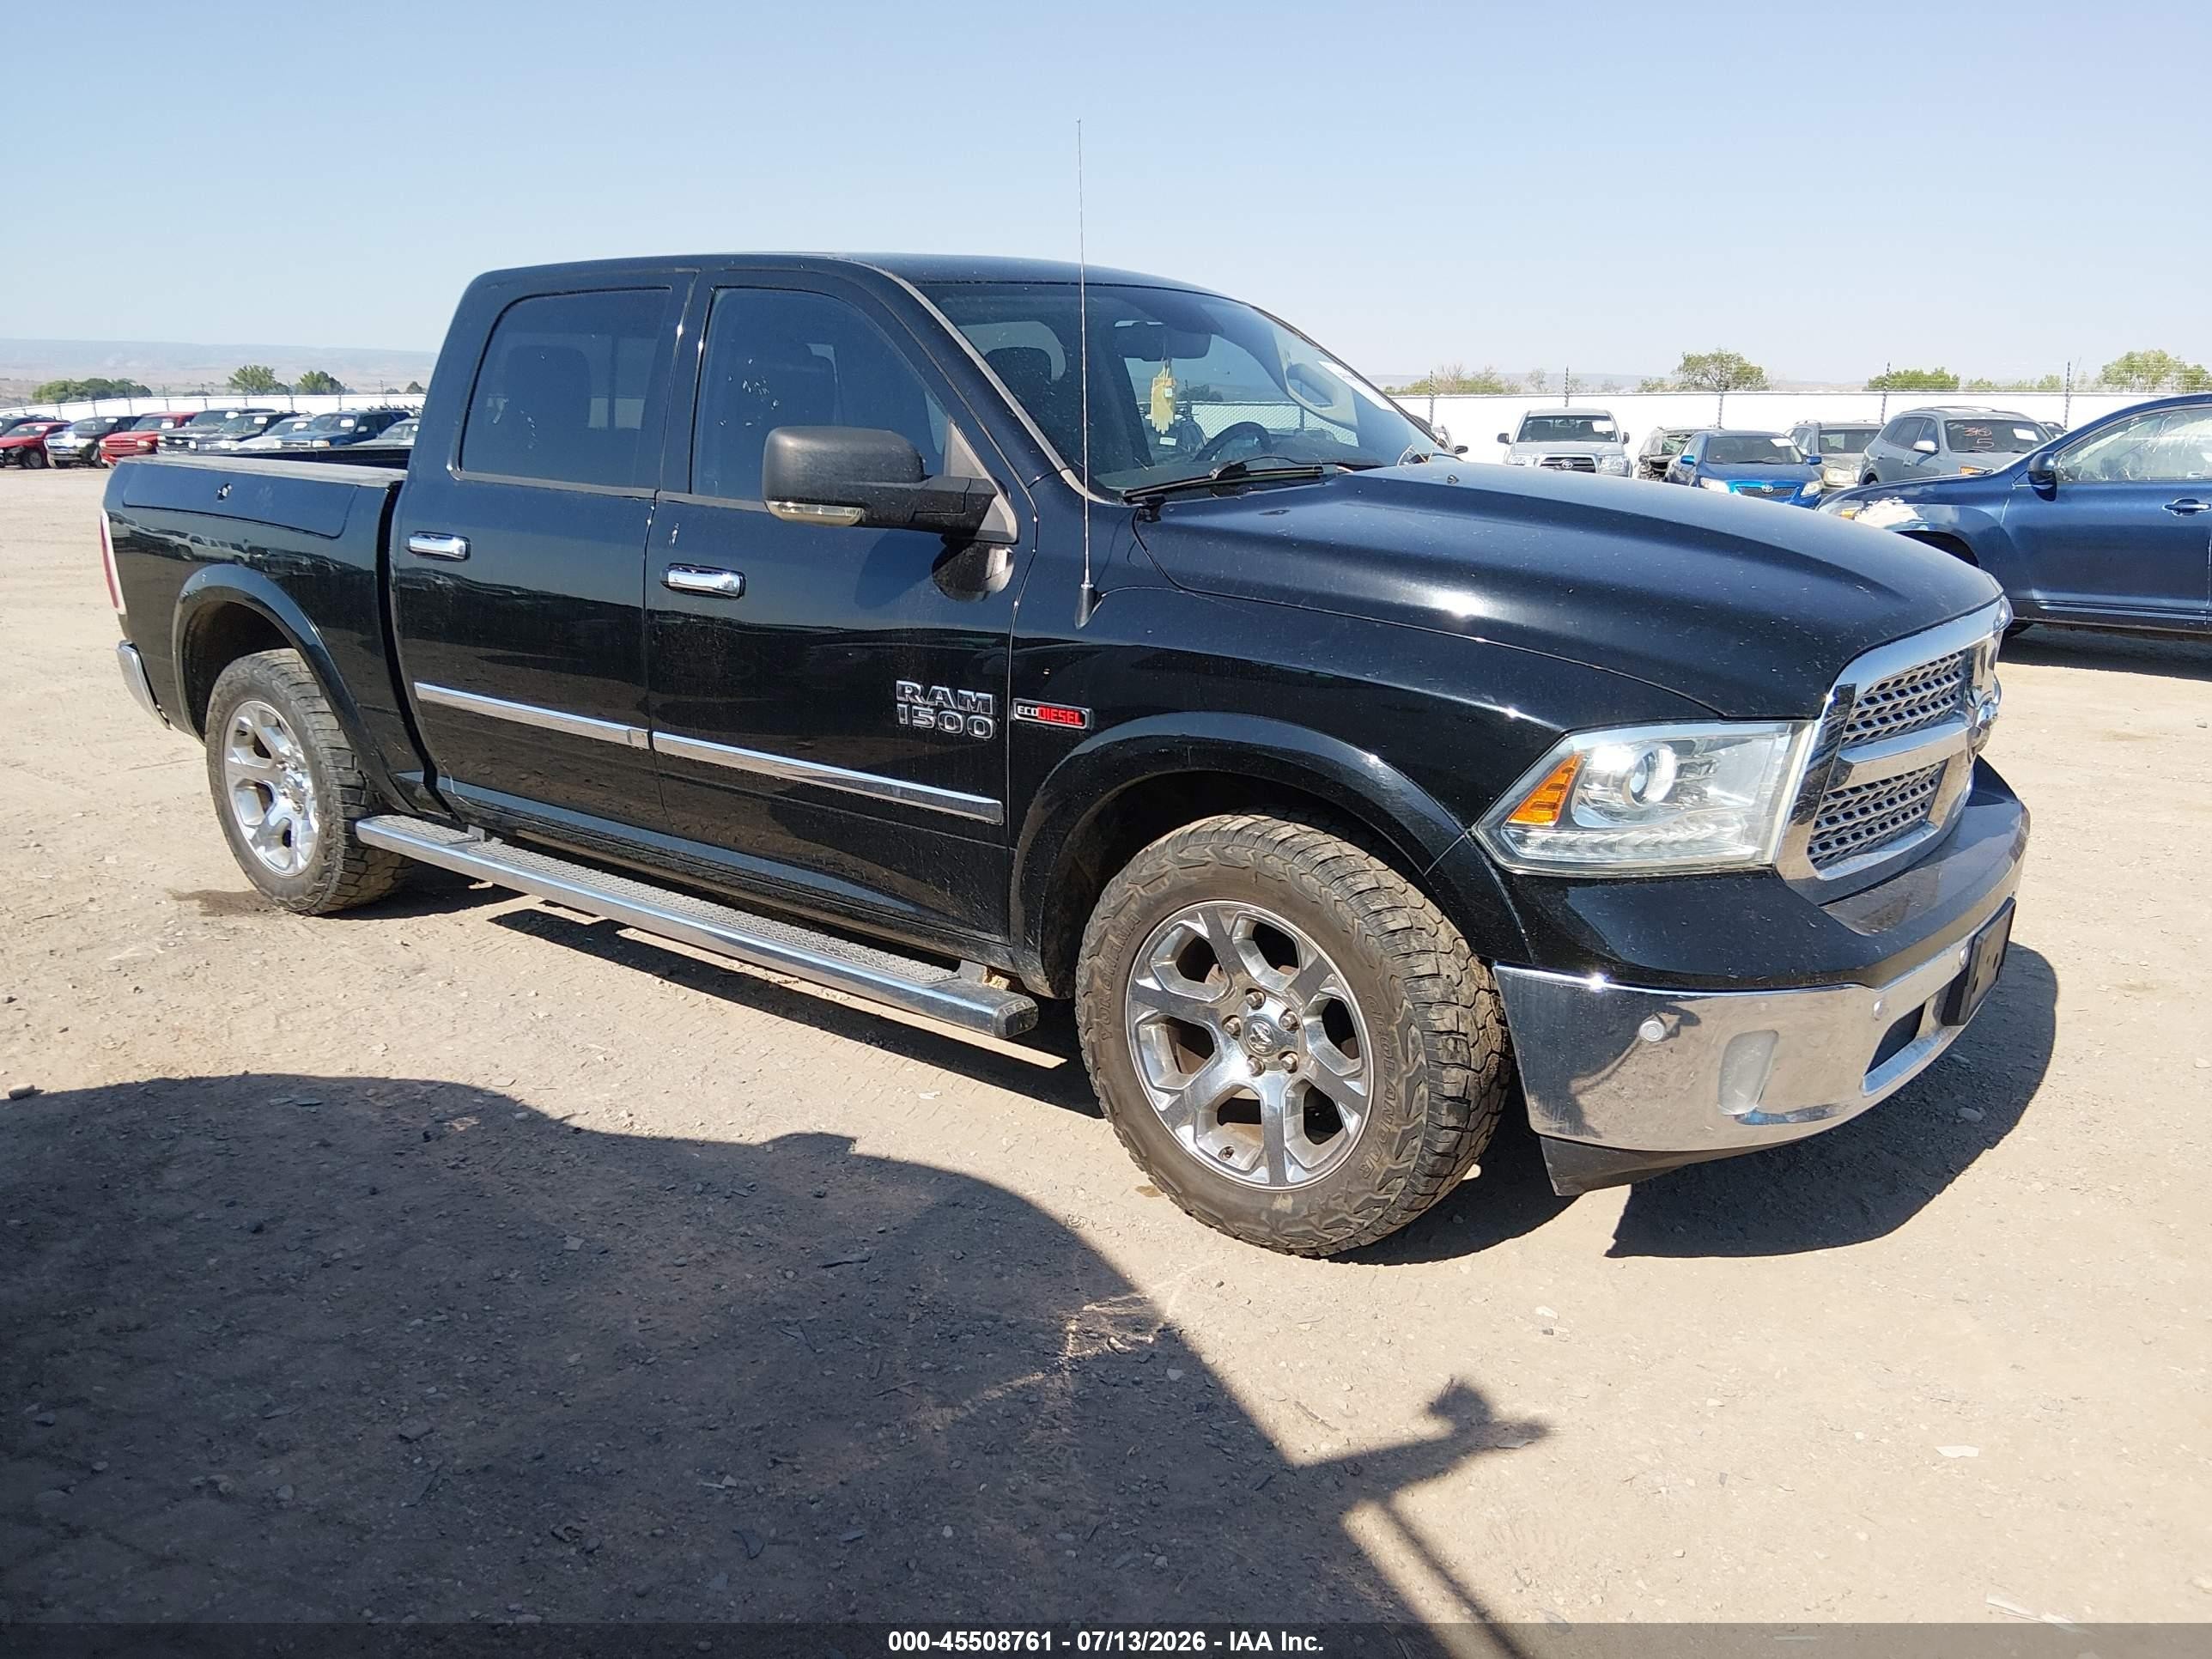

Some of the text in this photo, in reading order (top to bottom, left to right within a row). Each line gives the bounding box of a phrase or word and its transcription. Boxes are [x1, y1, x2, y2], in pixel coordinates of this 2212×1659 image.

[896, 680, 994, 714] RAM
[896, 703, 994, 739] 1500
[1017, 705, 1083, 726] ECODIESEL
